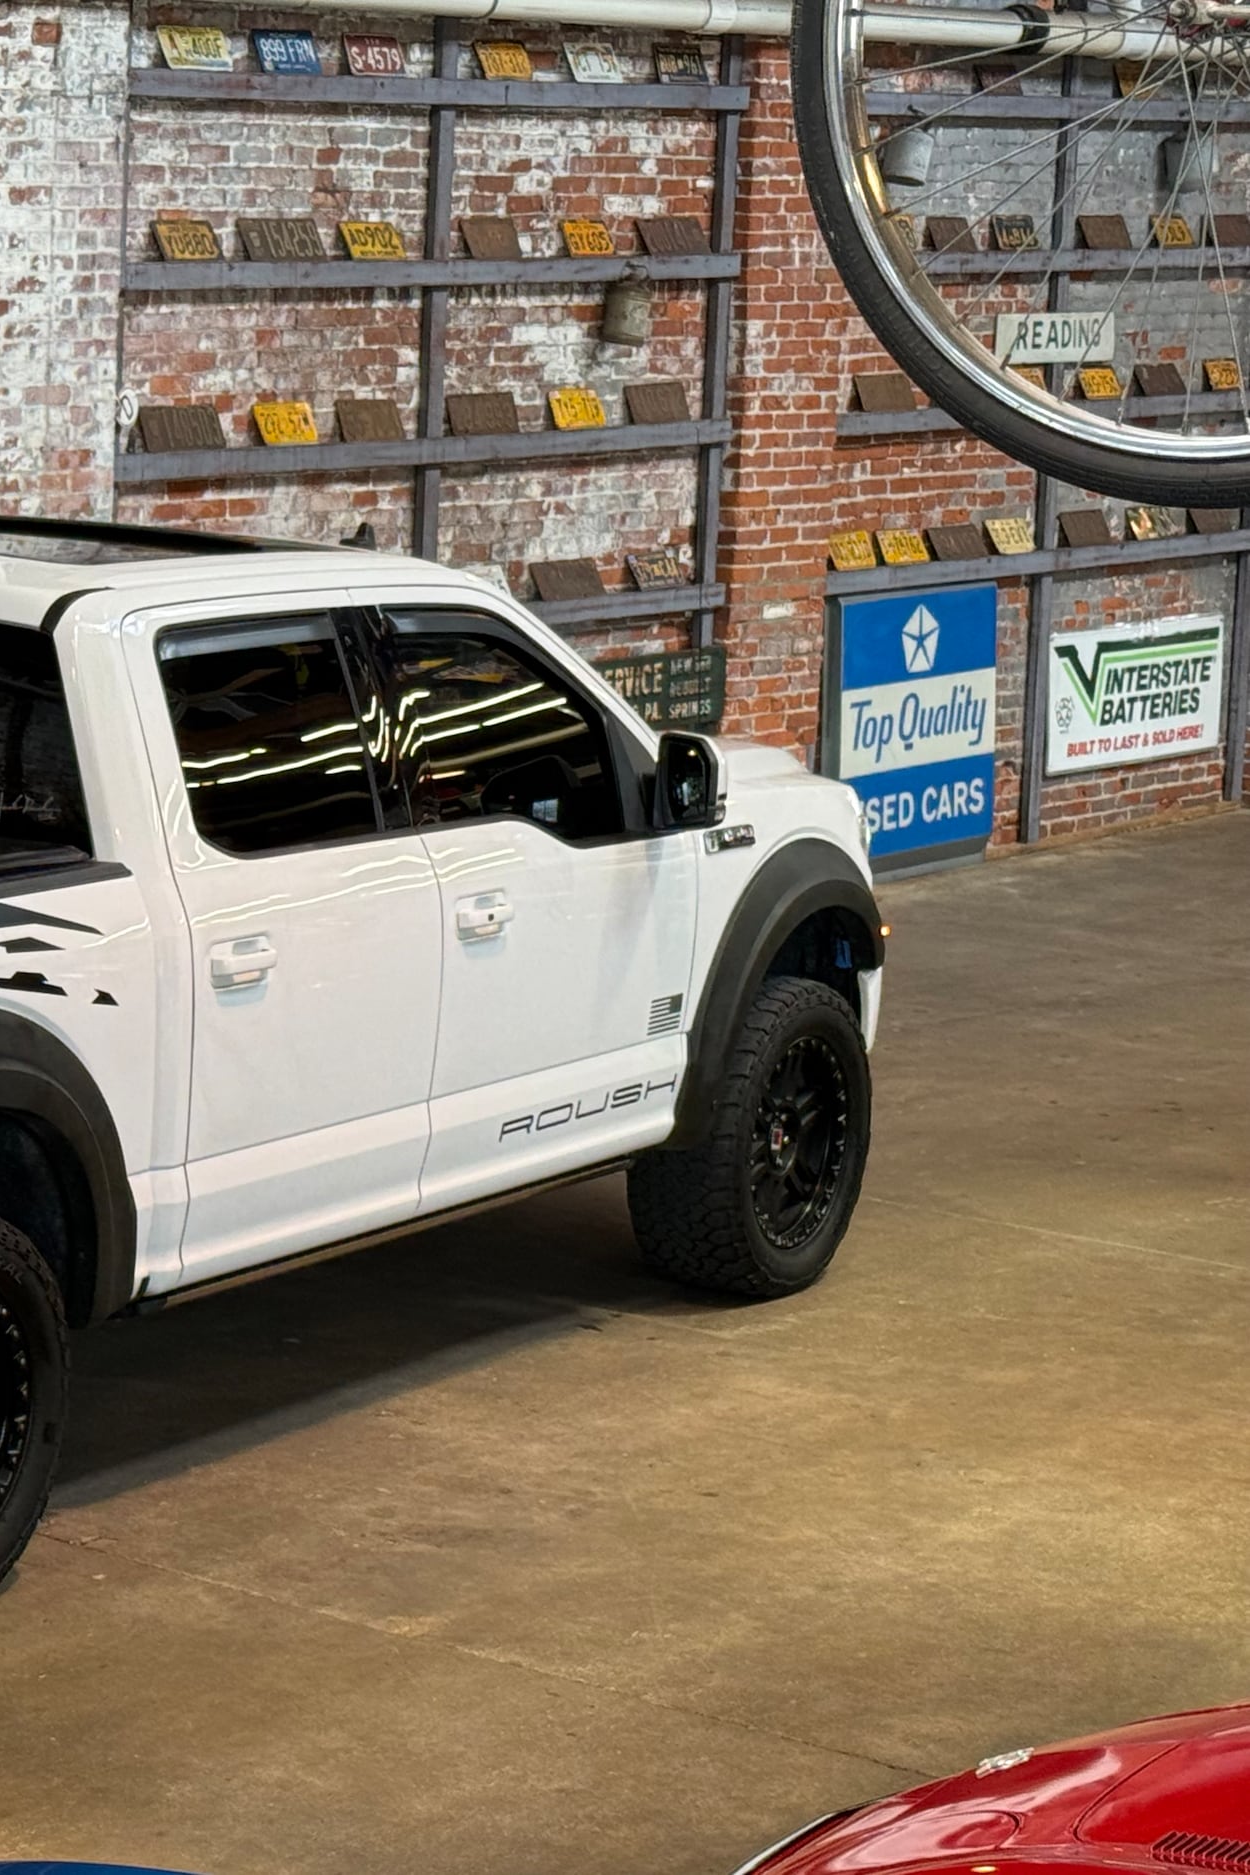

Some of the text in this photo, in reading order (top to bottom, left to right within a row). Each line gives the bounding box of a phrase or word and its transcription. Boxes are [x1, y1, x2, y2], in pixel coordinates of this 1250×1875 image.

[259, 38, 288, 63] 899
[347, 226, 400, 250] AD902
[1016, 318, 1101, 351] READING
[598, 662, 664, 699] ERVICE
[1104, 655, 1213, 696] INTERSTATE
[849, 684, 987, 764] Top Quality
[1099, 687, 1201, 727] BATTERIES
[1066, 740, 1096, 758] BUILT
[1098, 737, 1112, 753] TO
[1113, 733, 1141, 752] LAST
[1152, 728, 1176, 747] SOLD
[1176, 723, 1205, 742] HERE!
[861, 777, 985, 834] SED CARS
[498, 1073, 678, 1143] ROUSH
